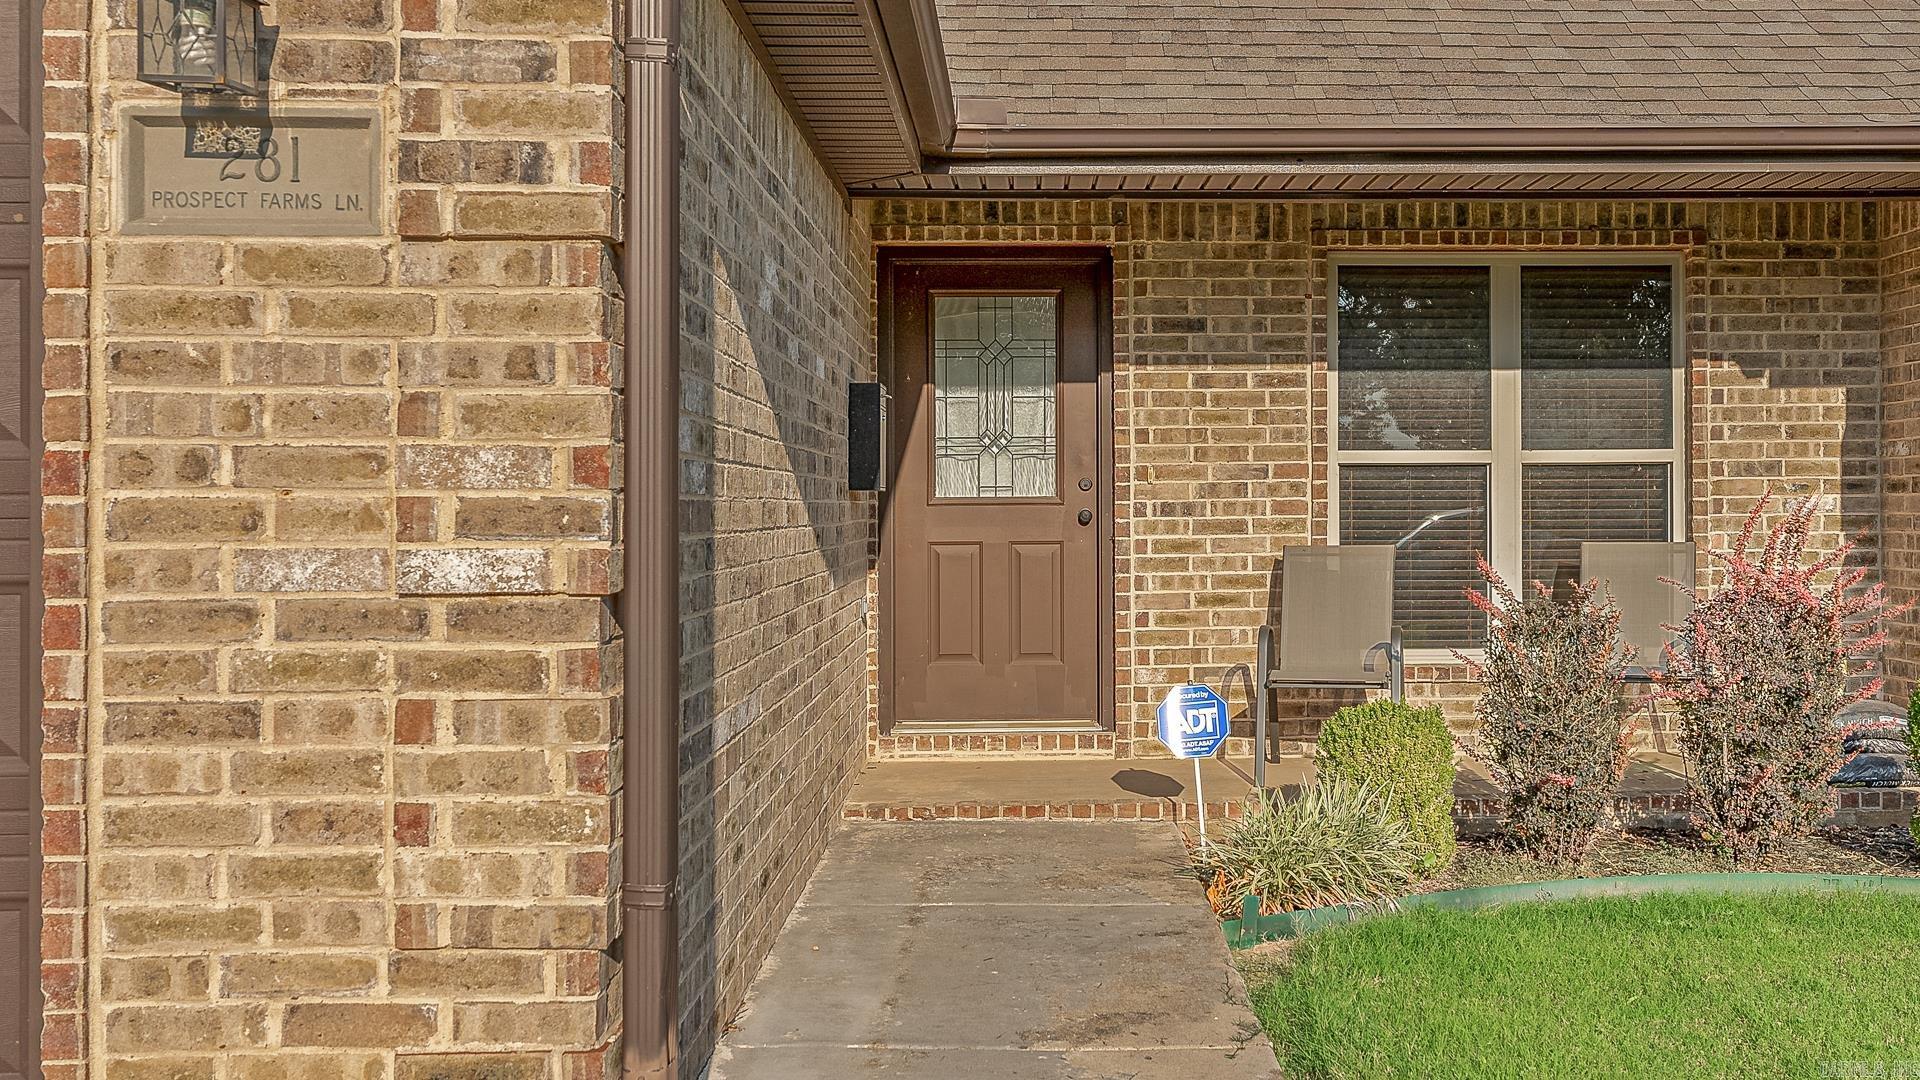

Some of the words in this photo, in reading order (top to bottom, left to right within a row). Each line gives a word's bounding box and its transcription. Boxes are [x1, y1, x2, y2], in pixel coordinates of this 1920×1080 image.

[219, 135, 300, 182] 281
[152, 191, 248, 209] PROSPECT
[261, 192, 322, 210] FARMS
[335, 194, 363, 211] LN.
[1200, 690, 1209, 699] by
